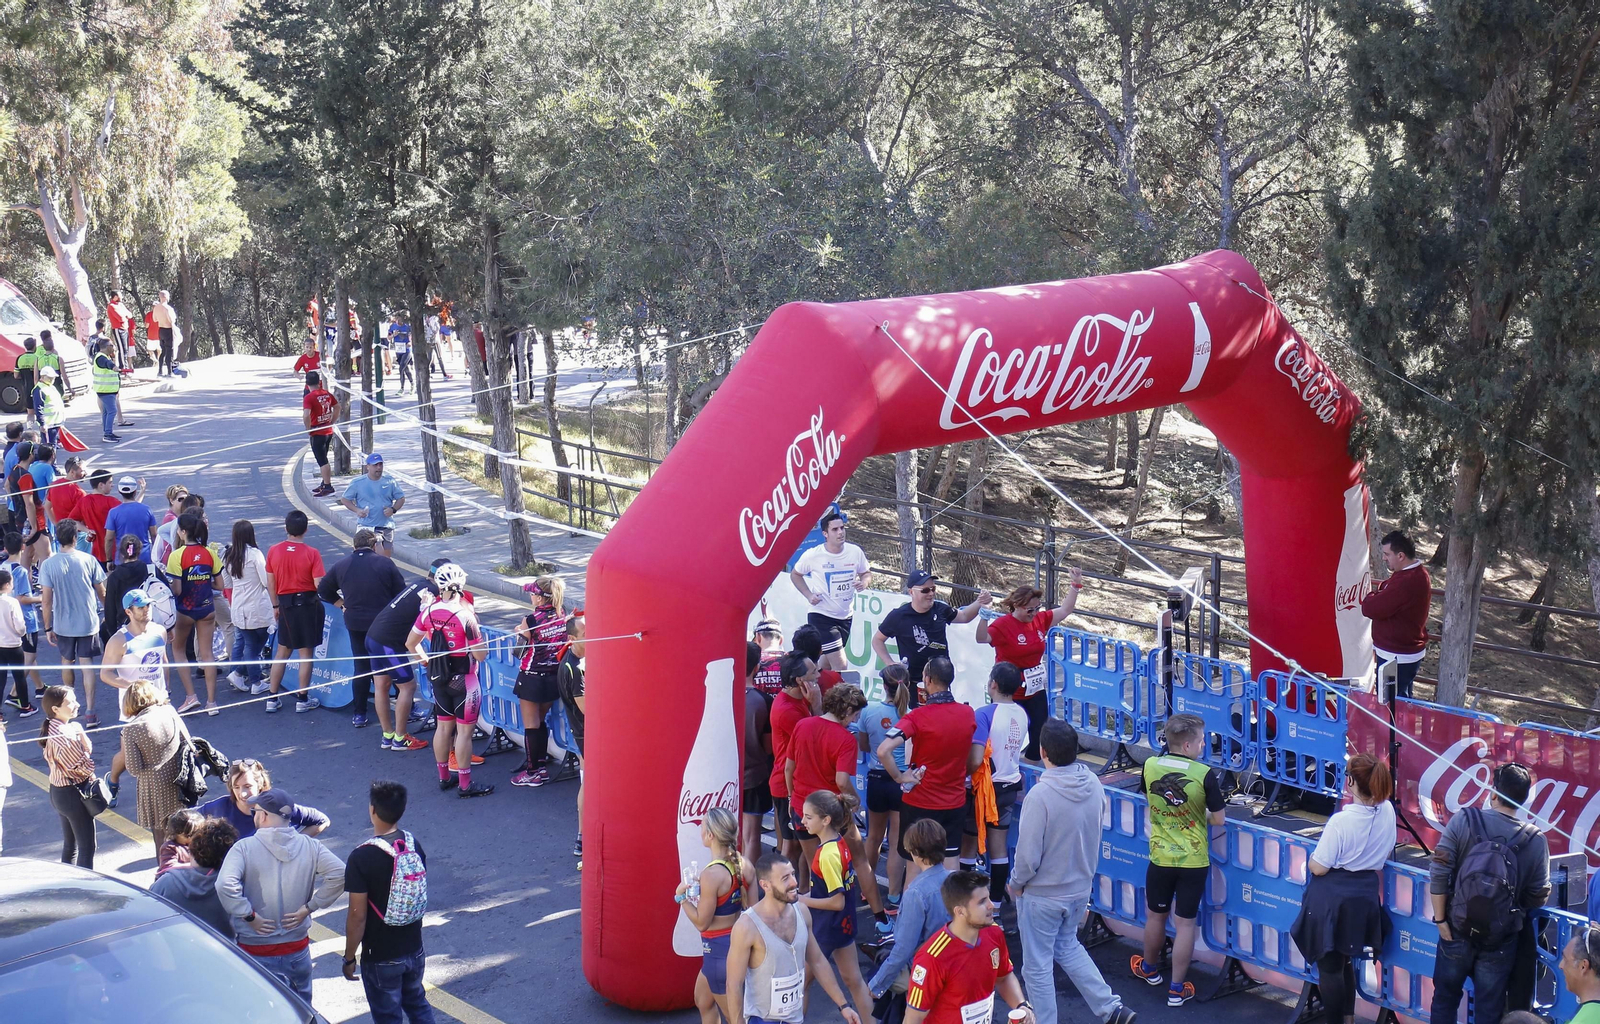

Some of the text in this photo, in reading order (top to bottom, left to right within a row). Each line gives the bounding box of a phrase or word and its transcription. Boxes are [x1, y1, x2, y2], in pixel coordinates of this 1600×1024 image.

[939, 307, 1155, 430] Coca-Cola
[739, 405, 843, 567] Coca-Cola
[836, 583, 850, 591] 403
[1031, 677, 1042, 687] 558
[782, 989, 799, 1004] 611
